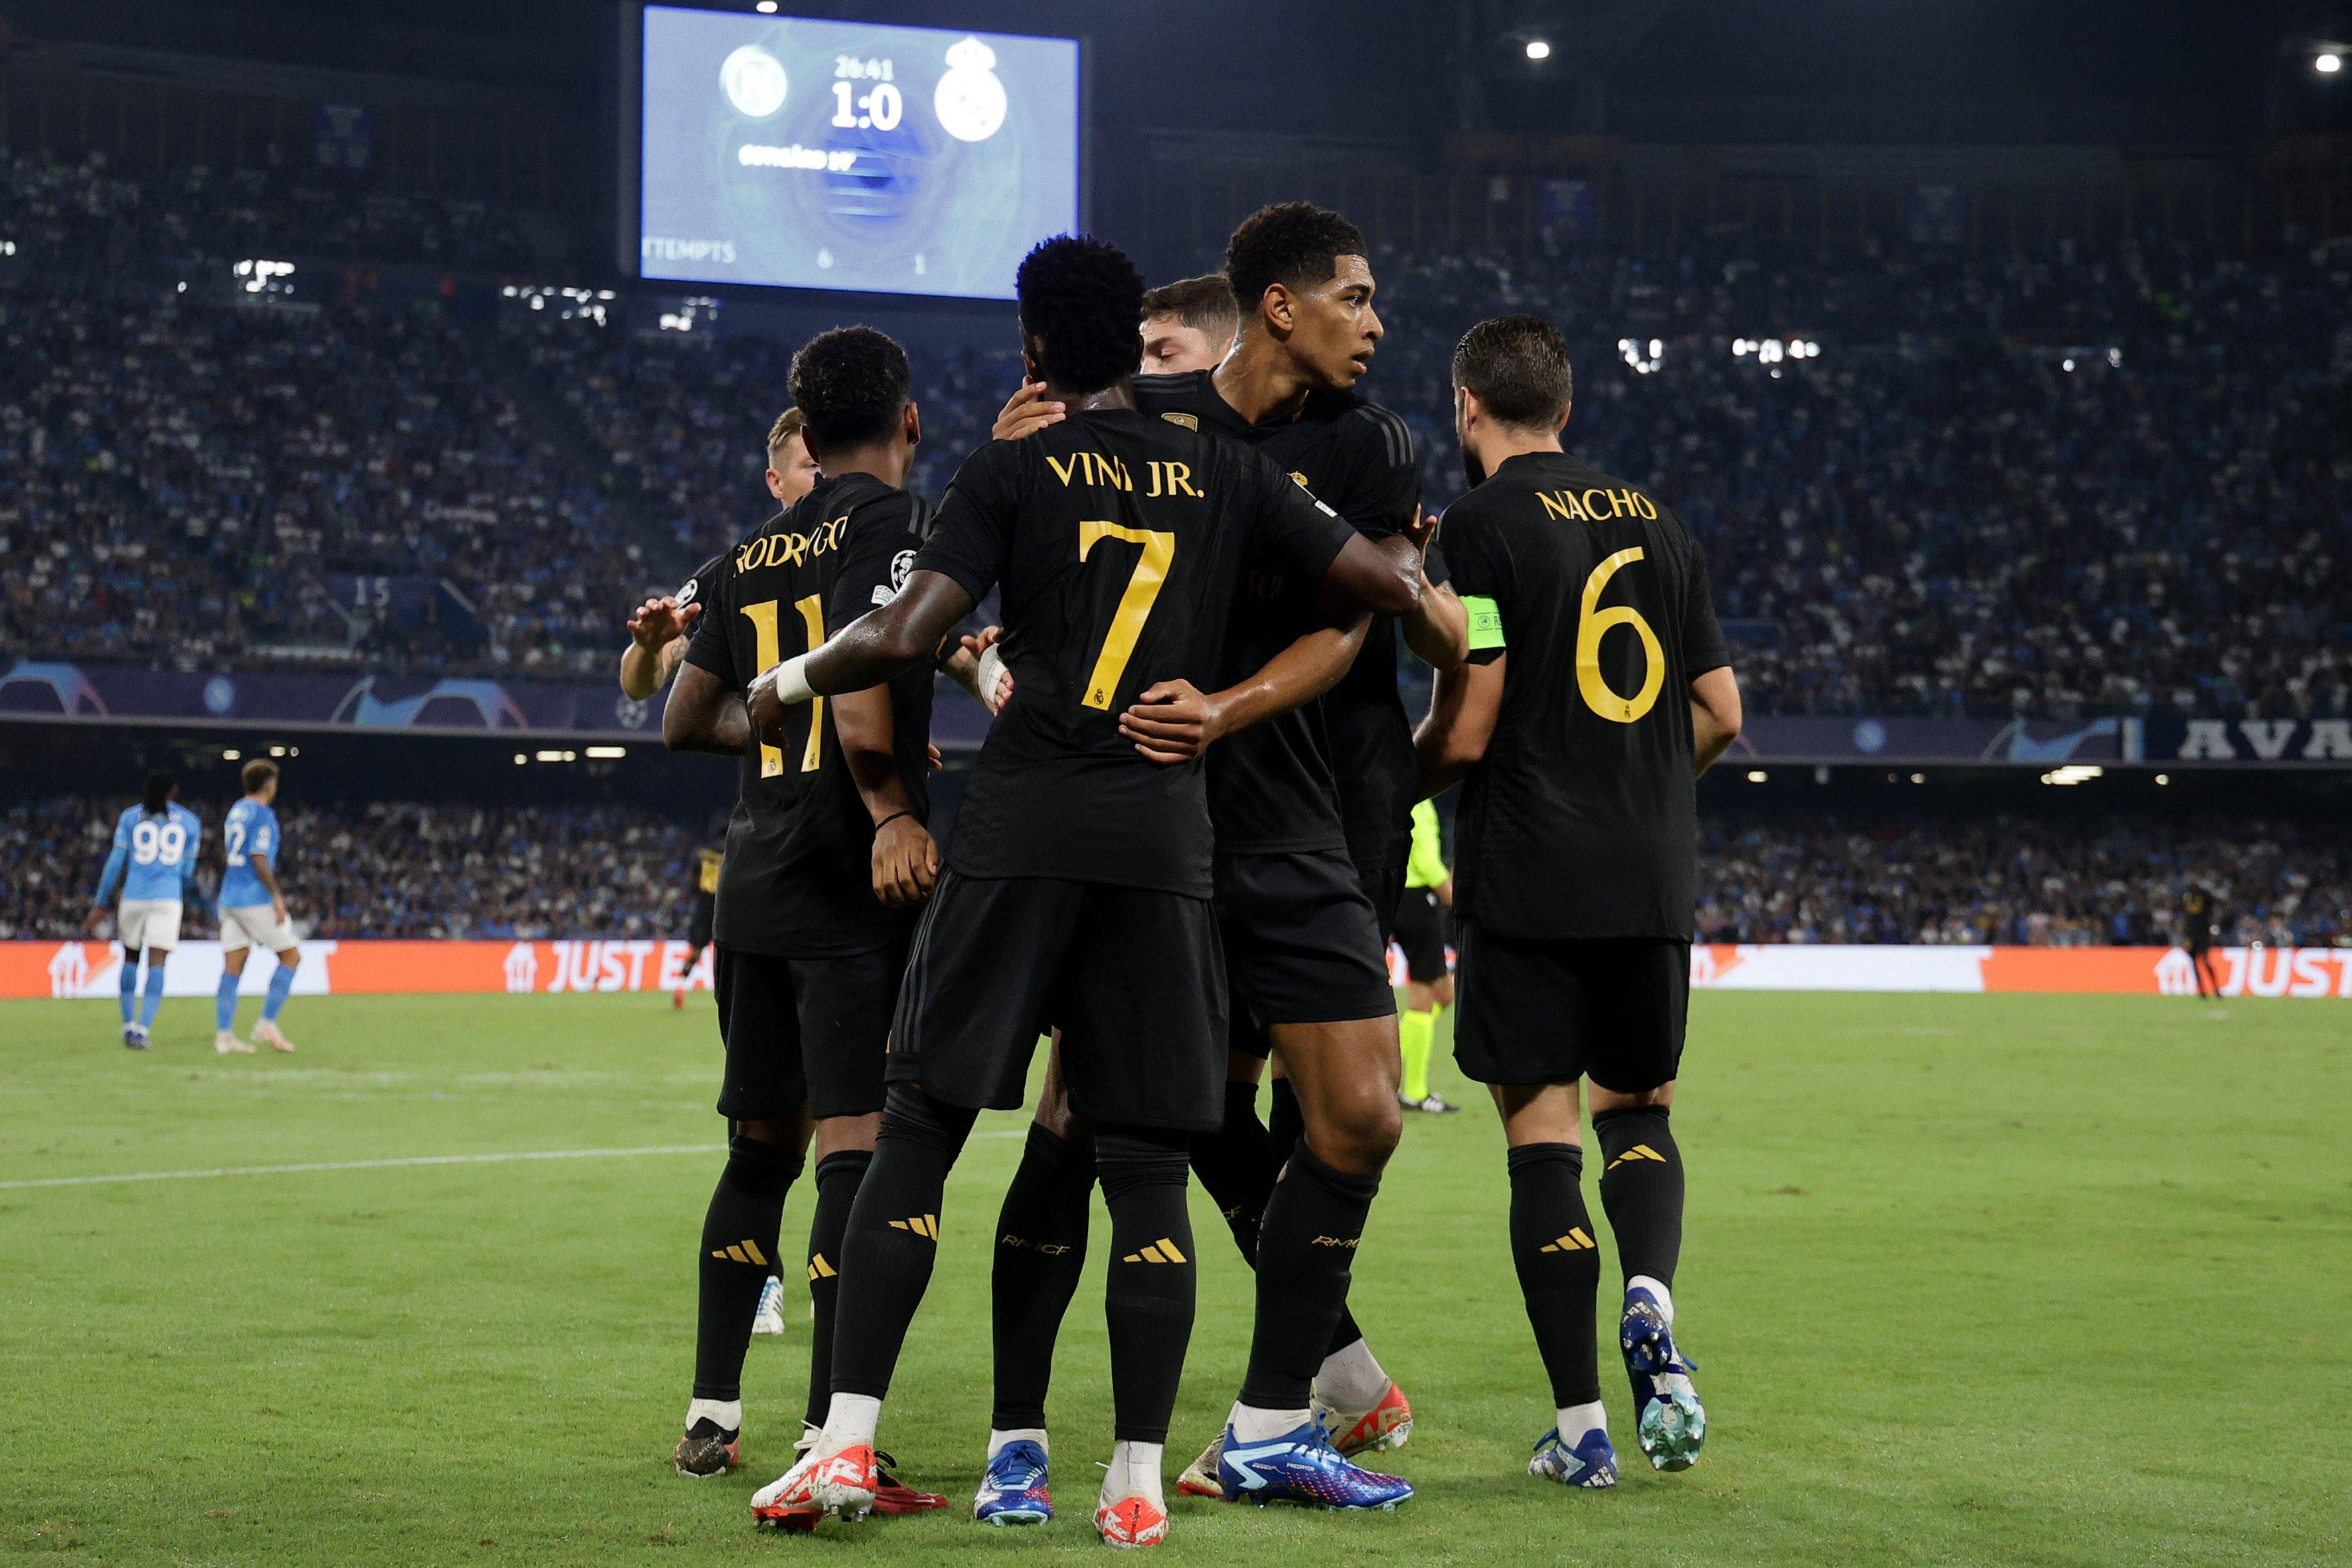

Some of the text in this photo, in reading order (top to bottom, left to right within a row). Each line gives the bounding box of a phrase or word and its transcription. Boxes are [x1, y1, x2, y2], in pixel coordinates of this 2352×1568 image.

[832, 81, 902, 131] 1:0
[1046, 452, 1204, 498] VINI JR.
[1535, 489, 1657, 522] NACHO
[1079, 520, 1175, 710] 7
[1575, 546, 1665, 723] 6
[740, 593, 826, 779] 11
[2177, 719, 2352, 759] AVA
[133, 821, 187, 866] 99
[547, 939, 655, 992] JUST
[2218, 947, 2352, 998] JUST
[1287, 1462, 1314, 1472] PREDATOR
